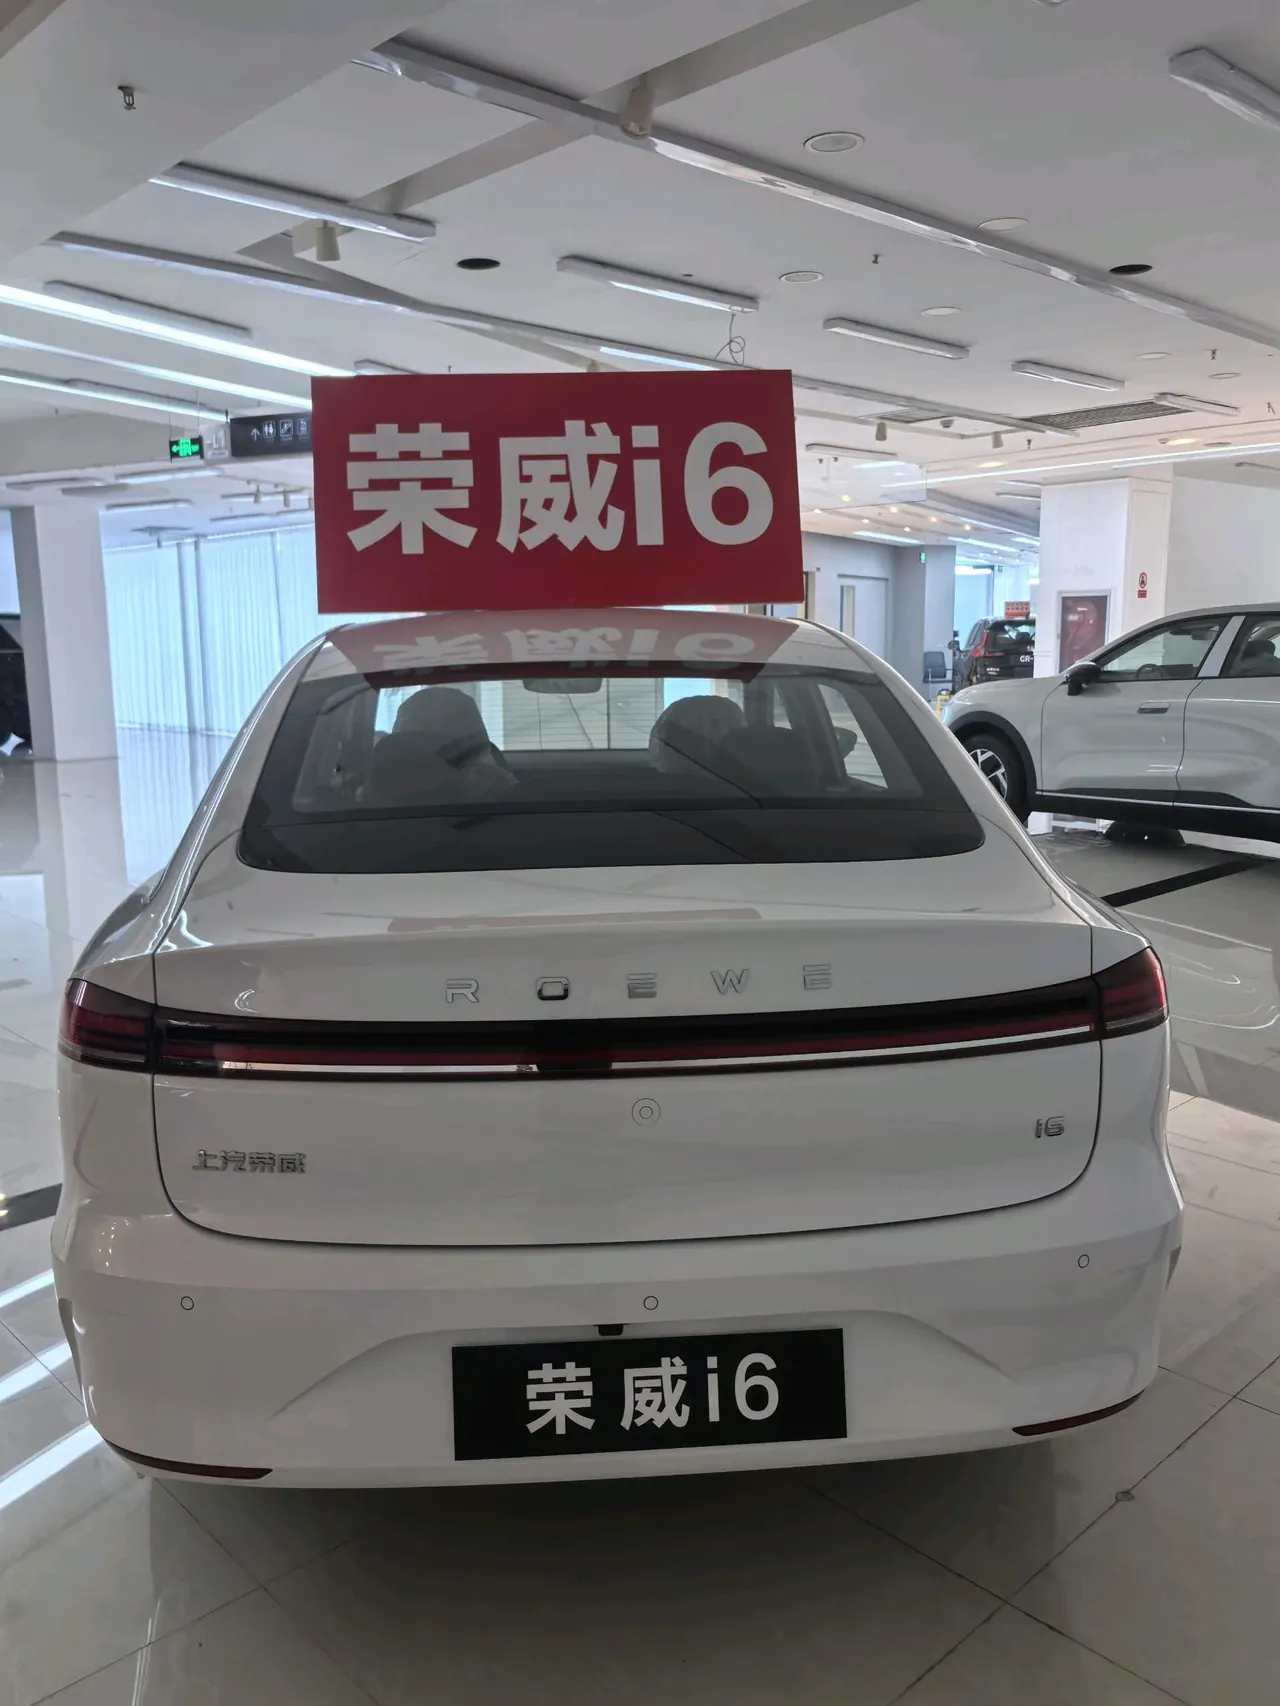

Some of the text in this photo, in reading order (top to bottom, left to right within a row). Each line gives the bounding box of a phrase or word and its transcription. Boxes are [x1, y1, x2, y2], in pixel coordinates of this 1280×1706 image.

[346, 419, 775, 555] 荣威i6
[445, 964, 832, 1003] ROEWE
[1035, 1115, 1065, 1139] i6
[191, 1149, 306, 1173] 上汽荣威
[525, 1352, 780, 1435] 荣威i6
